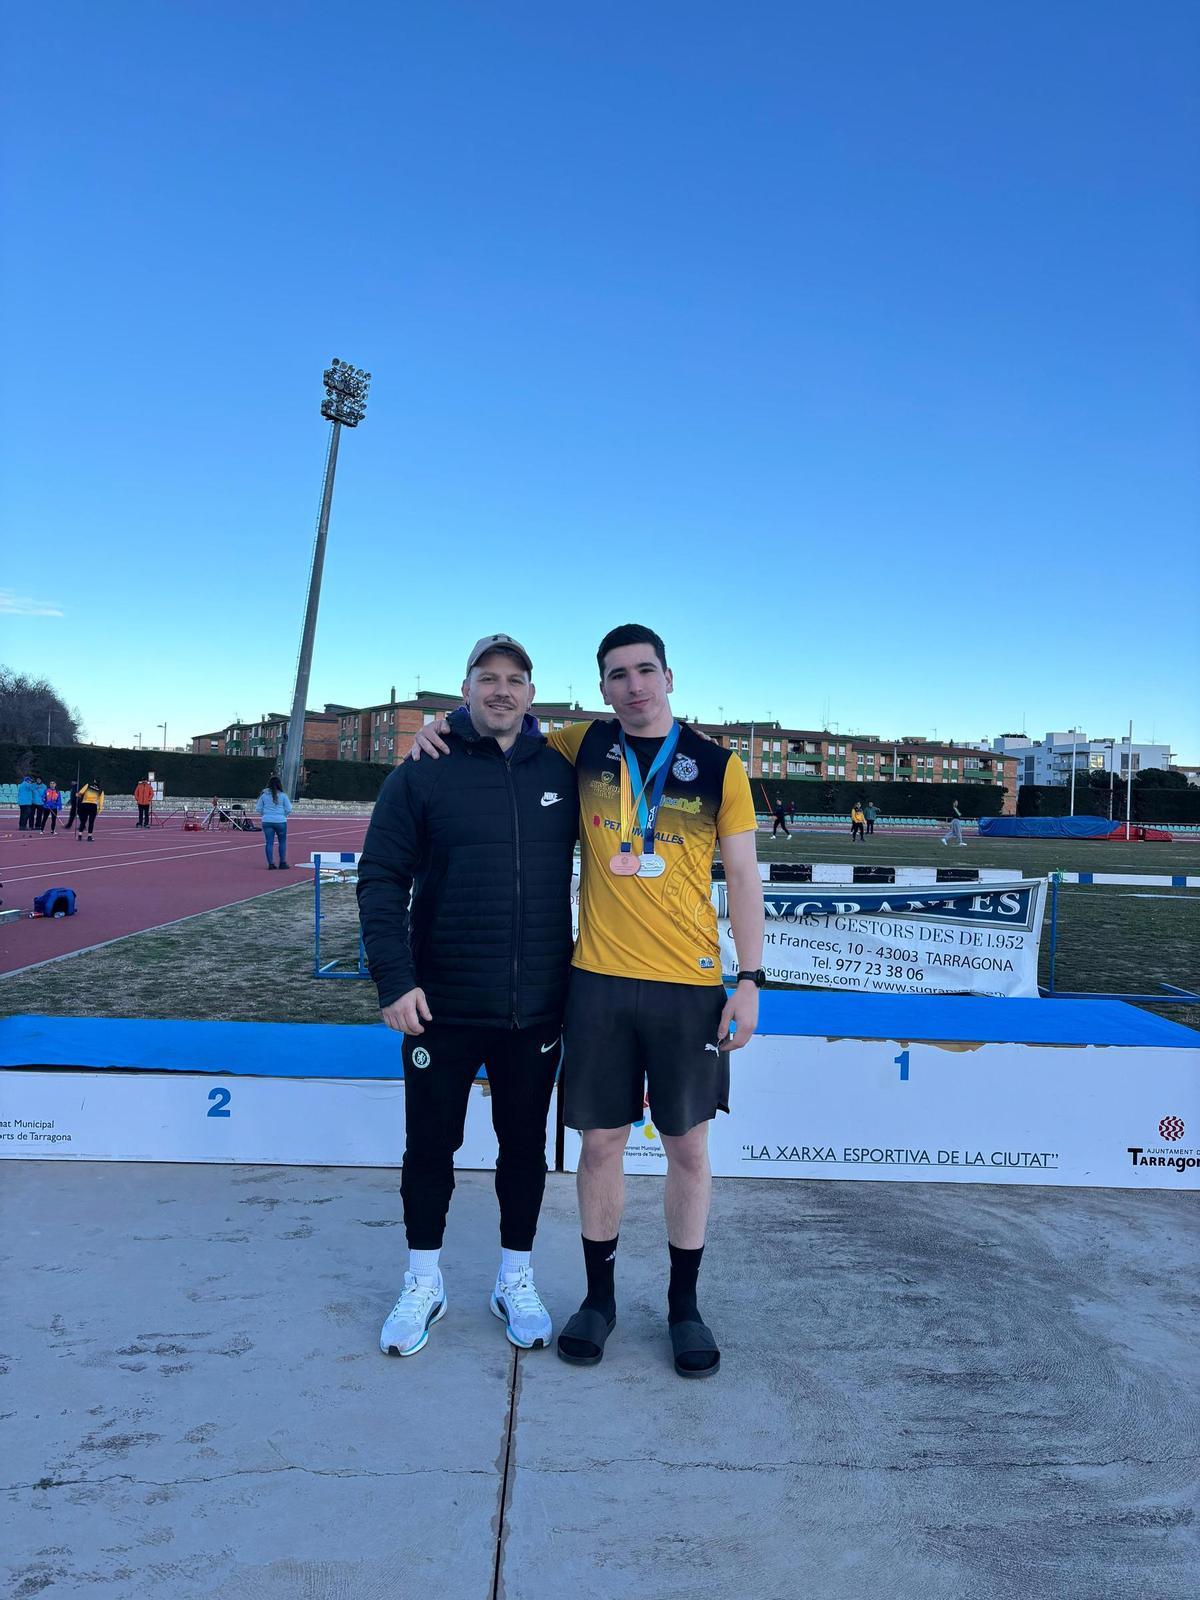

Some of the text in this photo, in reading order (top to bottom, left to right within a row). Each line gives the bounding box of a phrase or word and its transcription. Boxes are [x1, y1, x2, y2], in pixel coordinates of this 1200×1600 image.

[835, 916, 914, 939] GESTORS
[919, 926, 955, 944] DES
[959, 931, 984, 947] DE
[780, 933, 842, 955] Francesc,
[848, 942, 864, 955] 10
[875, 946, 919, 963] 43003
[925, 951, 1014, 972] TARRAGONA
[811, 956, 924, 981] Tel. 977 23 38 06
[894, 1051, 910, 1081] 1
[207, 1087, 232, 1118] 2
[14, 1119, 55, 1131] Municipal
[17, 1131, 28, 1141] de
[29, 1131, 72, 1143] Tarragona
[776, 1145, 837, 1161] XARXA
[843, 1148, 931, 1163] ESPORTIVA
[937, 1150, 960, 1164] DE
[965, 1151, 986, 1165] LA
